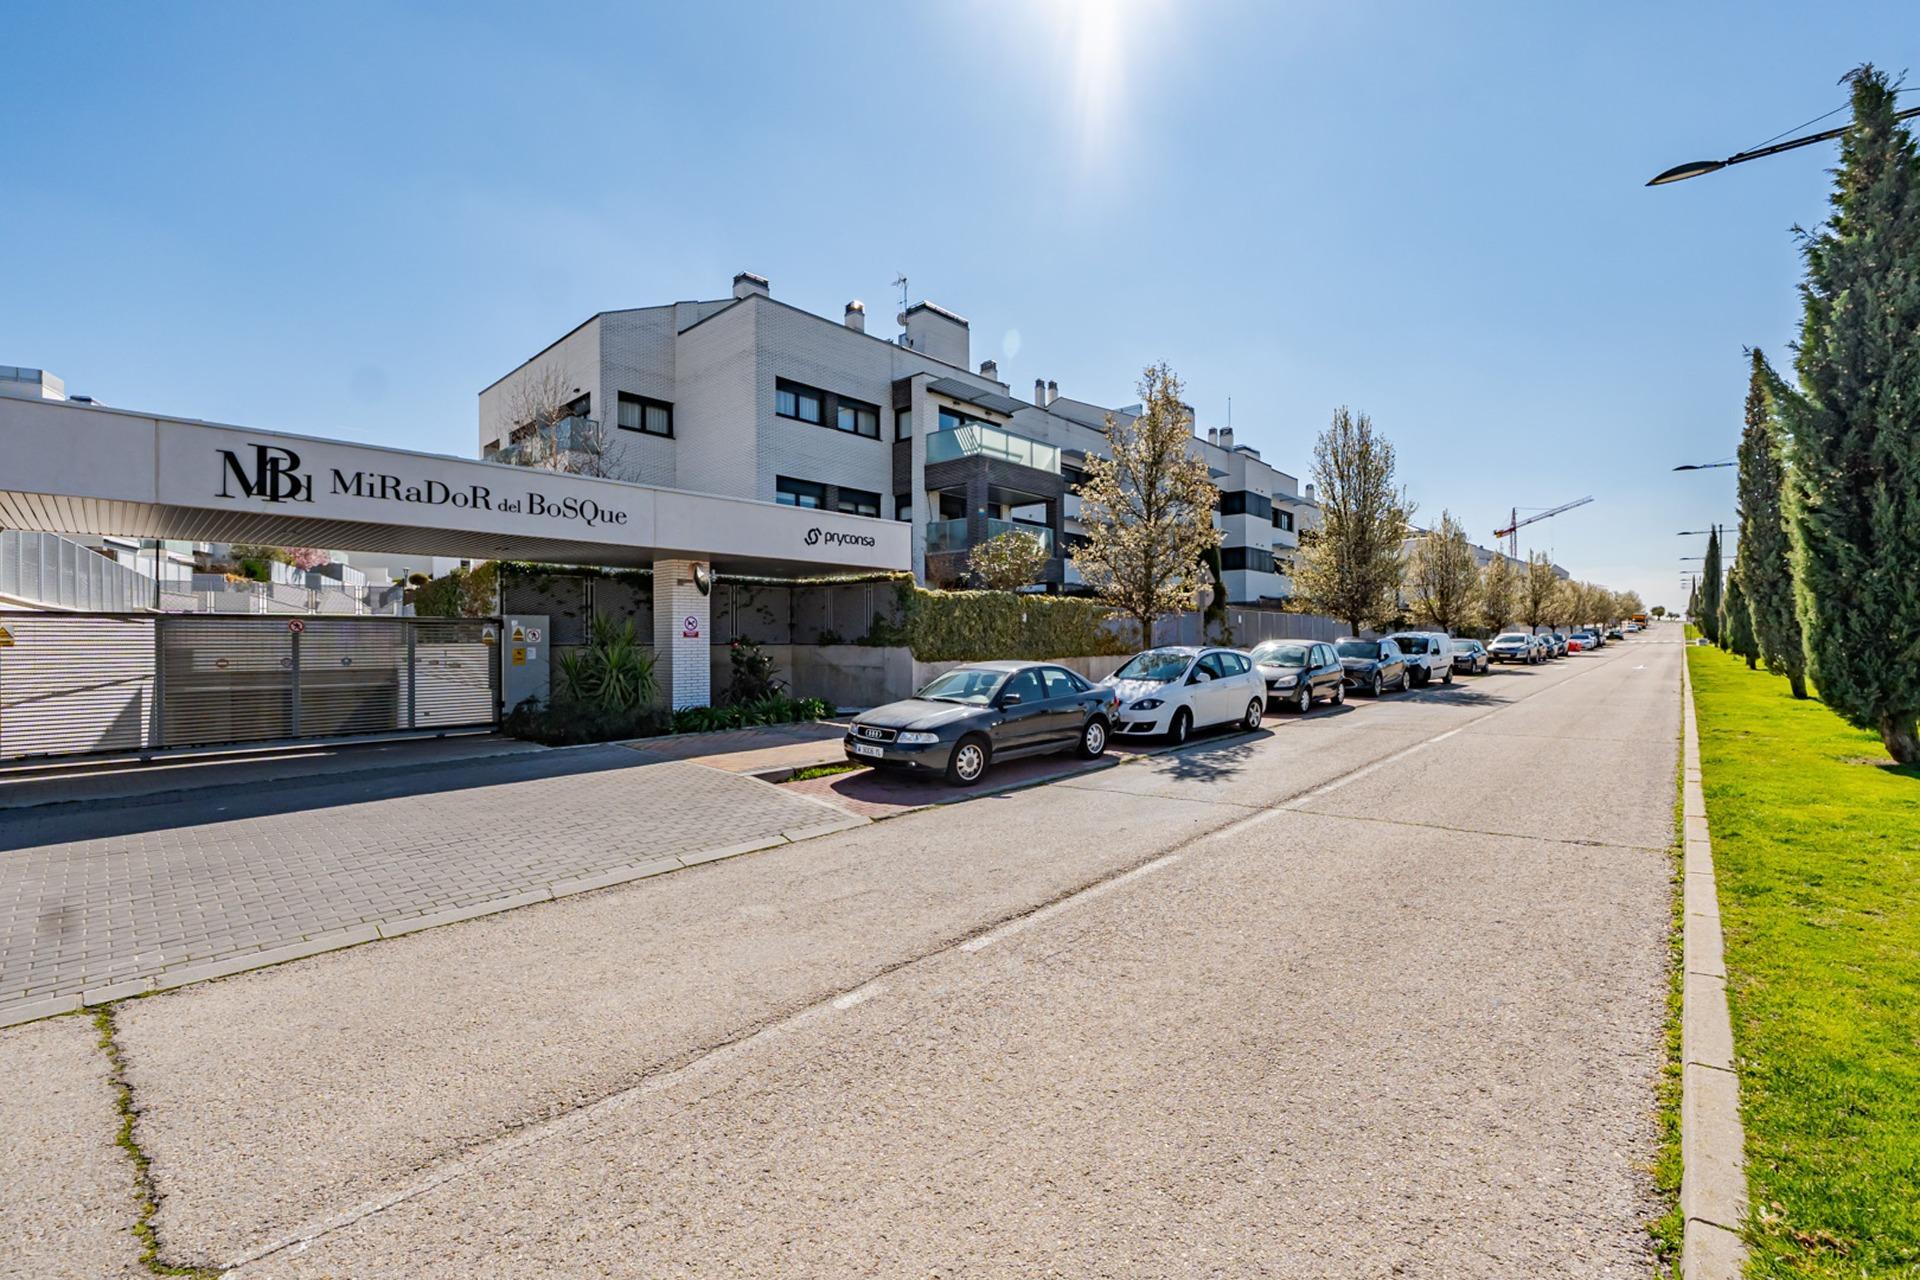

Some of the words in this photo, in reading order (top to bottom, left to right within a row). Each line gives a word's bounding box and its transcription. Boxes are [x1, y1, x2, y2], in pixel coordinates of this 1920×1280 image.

[330, 468, 492, 511] MiRaDoR
[497, 498, 521, 514] del
[526, 492, 628, 527] BoSQue
[824, 531, 876, 547] pryconsa
